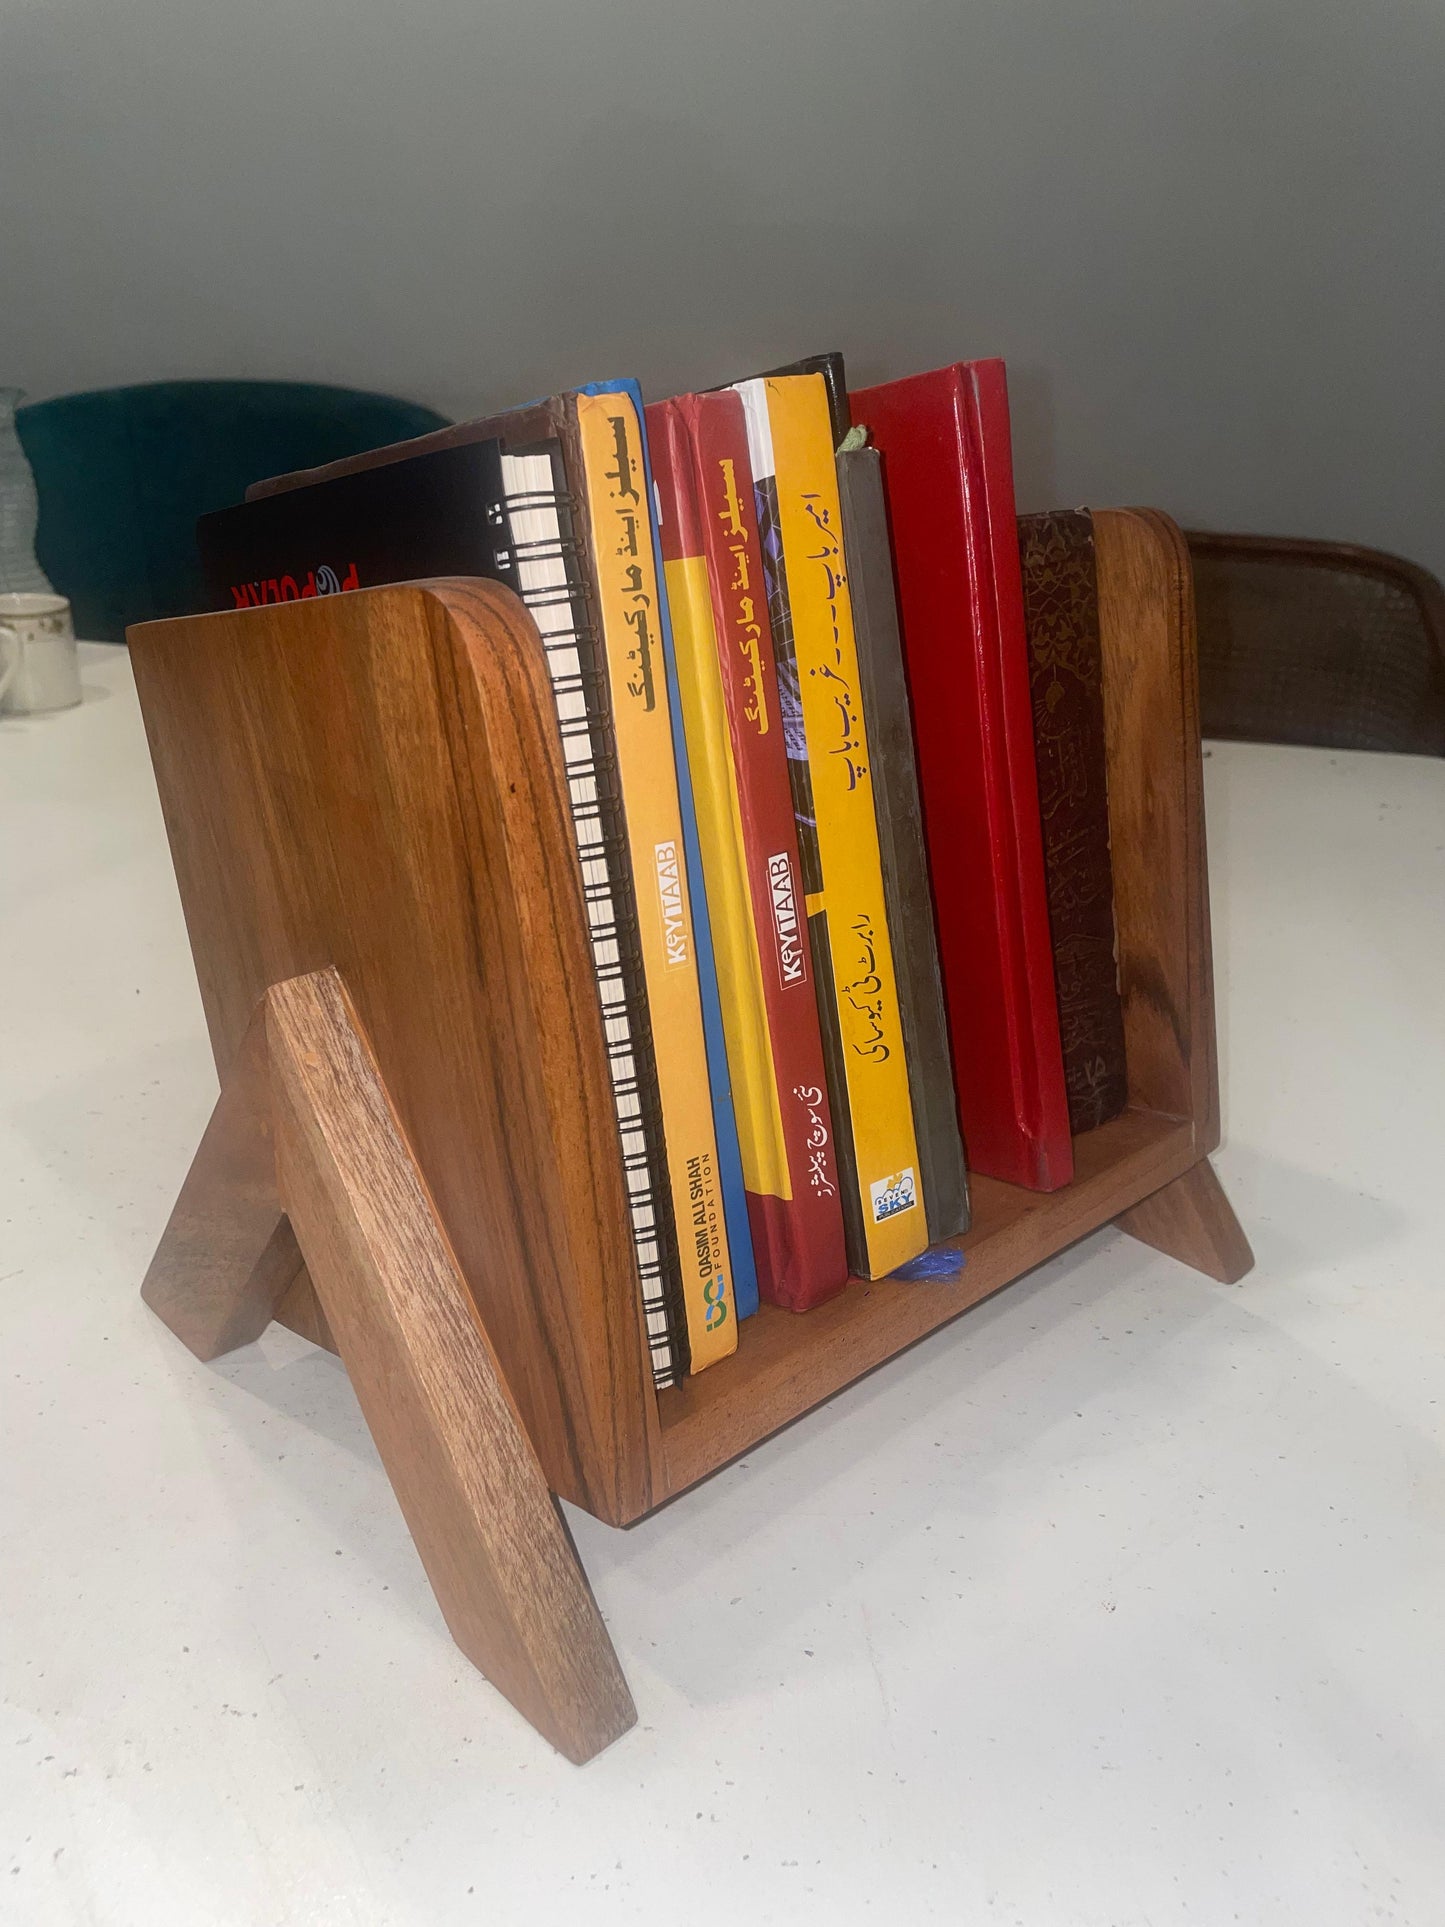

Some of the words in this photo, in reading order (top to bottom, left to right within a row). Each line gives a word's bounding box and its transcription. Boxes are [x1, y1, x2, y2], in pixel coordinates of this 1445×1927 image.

[604, 416, 639, 505] سیلز
[718, 458, 748, 542] سیلز
[800, 493, 838, 544] امیر
[615, 508, 639, 556] اینڈ
[729, 545, 751, 590] اینڈ
[806, 546, 847, 600] باپ
[620, 565, 656, 712] مارکیٹنگ
[735, 596, 769, 735] مارکیٹنگ
[809, 663, 857, 737] غریب
[828, 740, 866, 791] باپ
[686, 1156, 704, 1199] SHAH
[878, 1189, 905, 1204] SEVEN
[878, 1192, 912, 1214] SKY
[690, 1202, 707, 1226] ALI
[701, 1153, 722, 1270] FOUNDATION
[692, 1228, 714, 1278] QASIM
